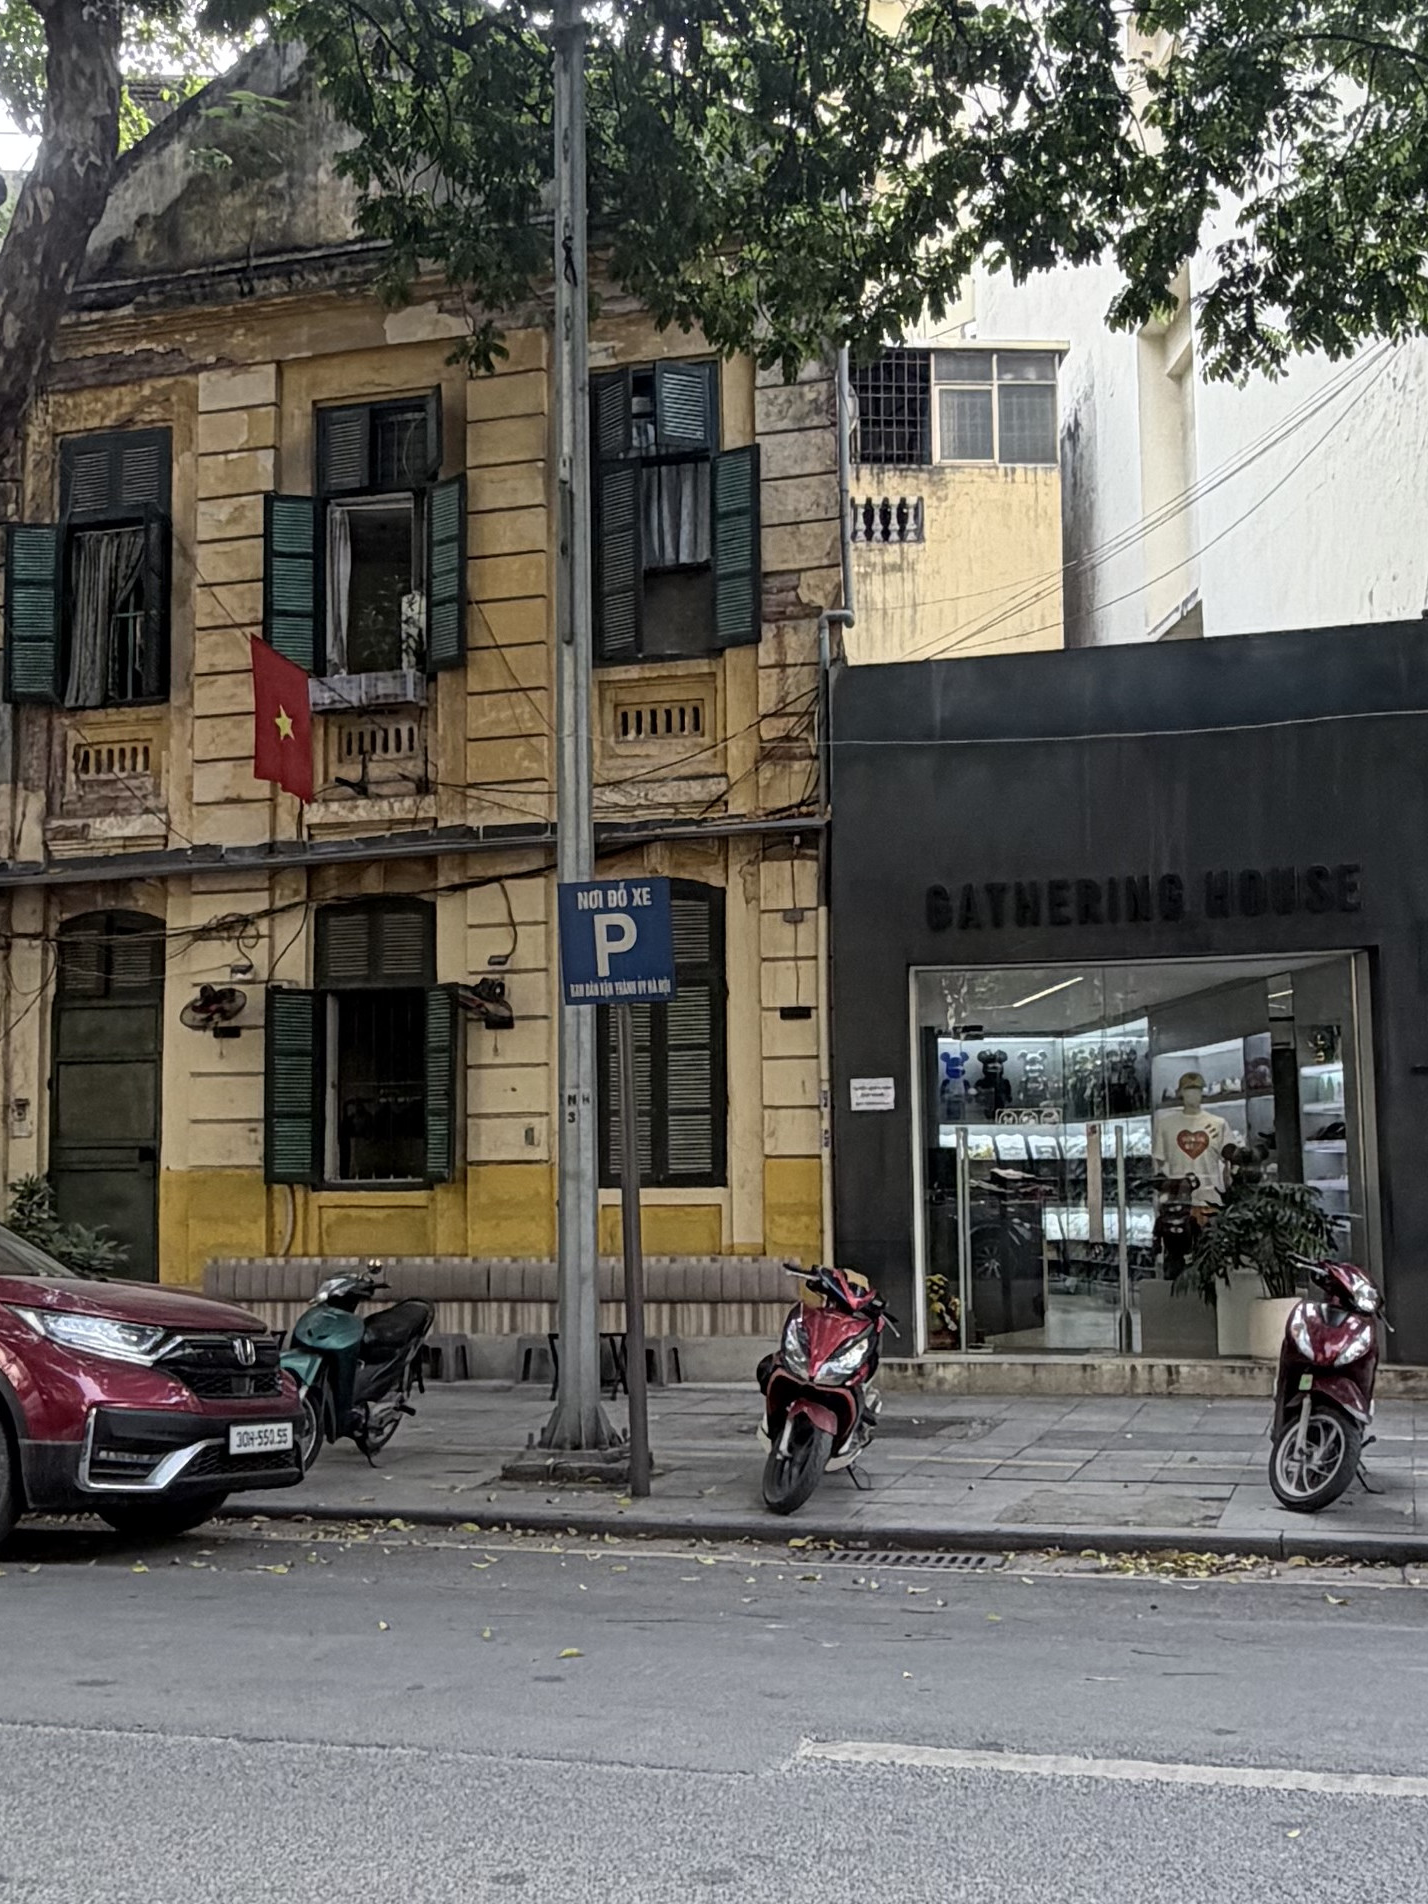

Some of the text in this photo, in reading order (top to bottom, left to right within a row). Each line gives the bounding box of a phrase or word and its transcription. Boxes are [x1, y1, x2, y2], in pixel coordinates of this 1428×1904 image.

[632, 887, 652, 907] XE
[925, 864, 1363, 932] GATHERING HOUSE
[594, 913, 637, 977] P
